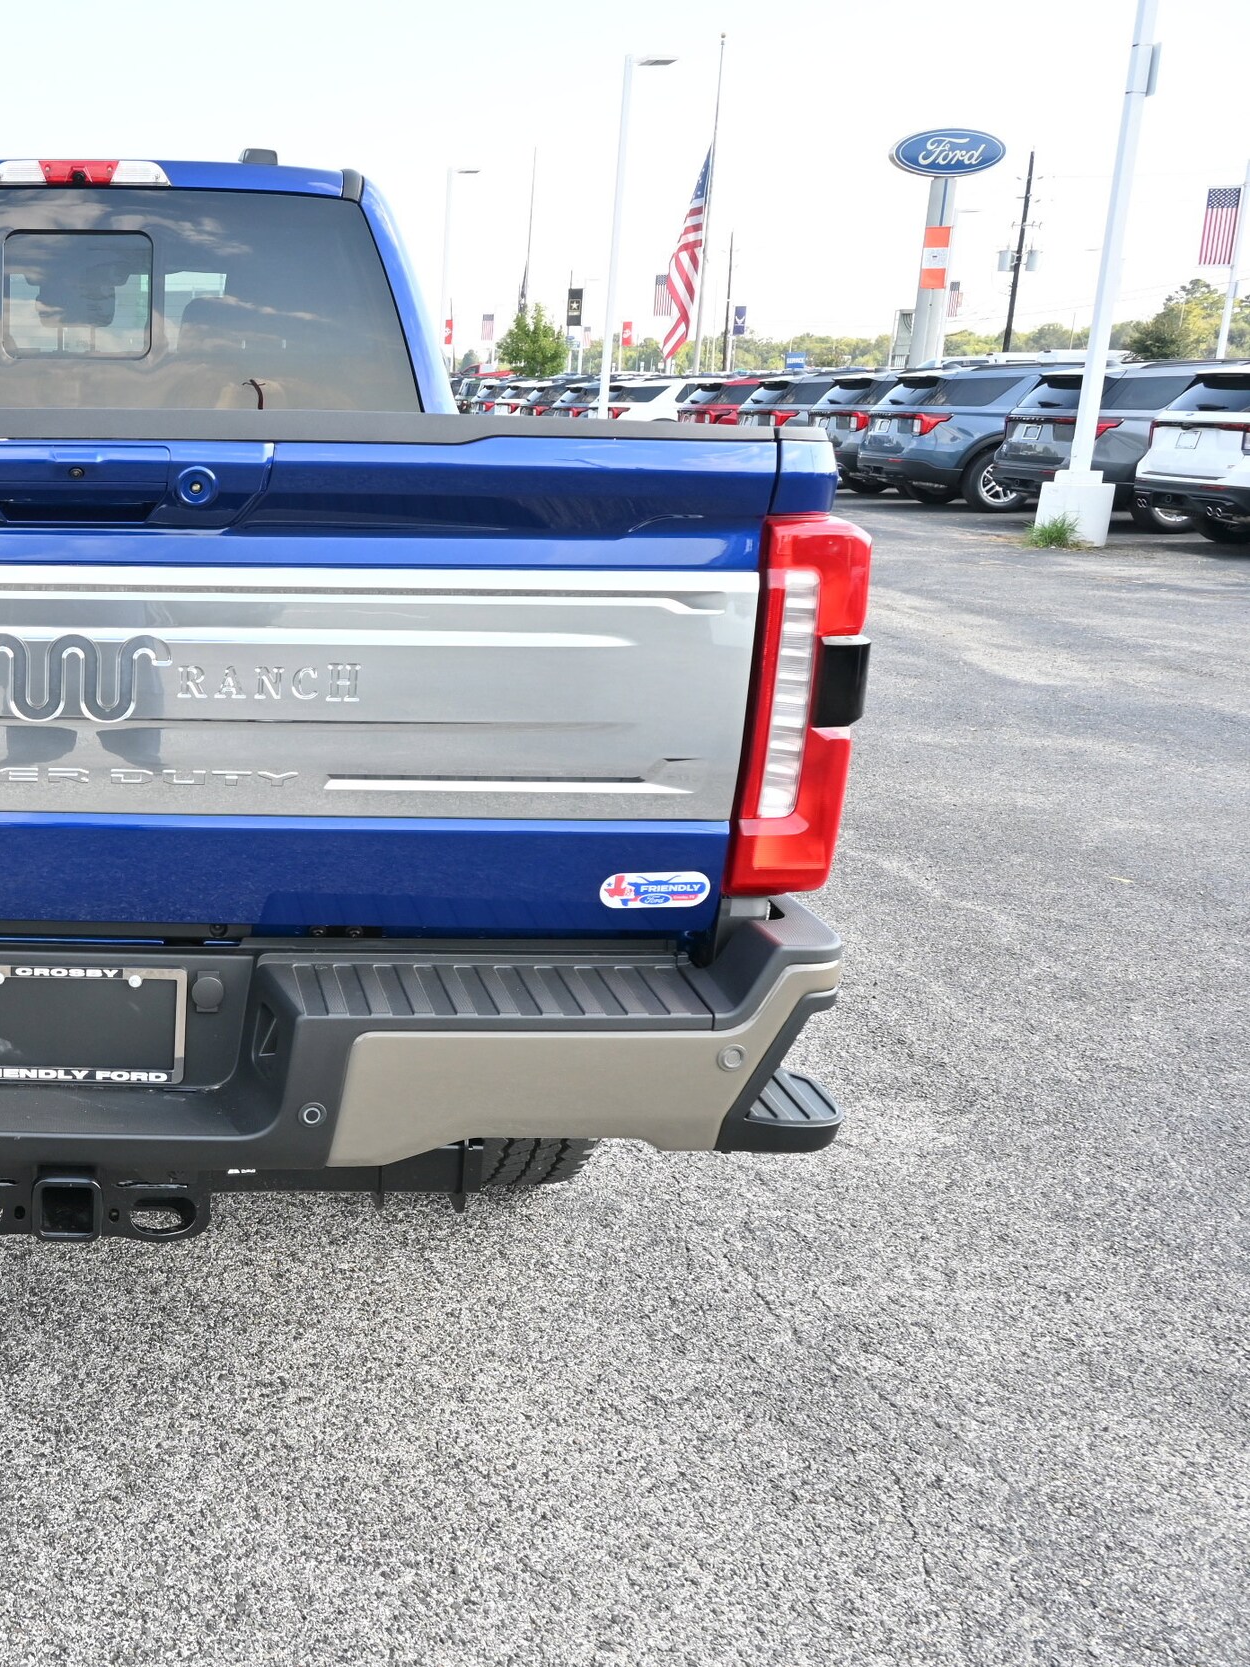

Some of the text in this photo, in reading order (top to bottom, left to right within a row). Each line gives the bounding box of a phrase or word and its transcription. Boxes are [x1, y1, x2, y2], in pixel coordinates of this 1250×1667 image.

[918, 137, 986, 165] Ford
[177, 662, 361, 702] RANCH
[640, 884, 701, 893] FRIENDLY
[644, 895, 665, 904] Ford
[15, 967, 119, 978] CROSBY
[95, 1071, 168, 1082] FORD
